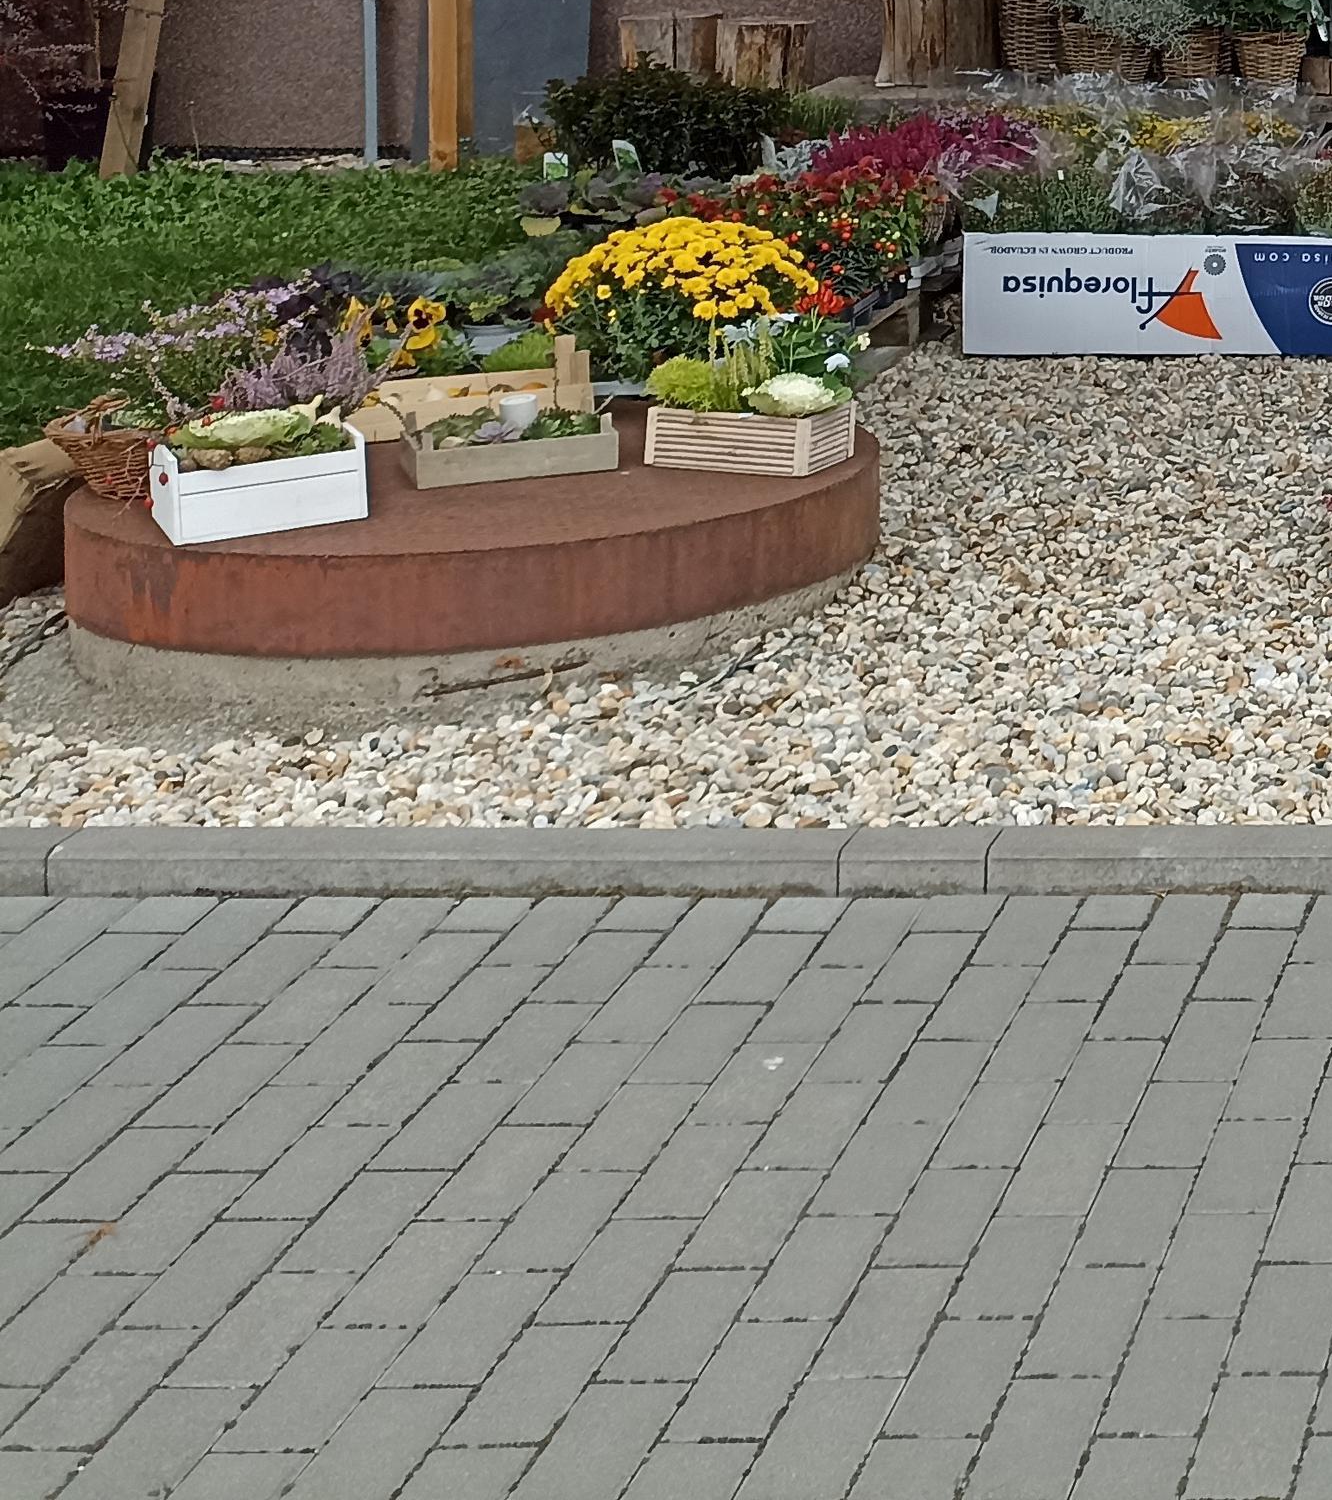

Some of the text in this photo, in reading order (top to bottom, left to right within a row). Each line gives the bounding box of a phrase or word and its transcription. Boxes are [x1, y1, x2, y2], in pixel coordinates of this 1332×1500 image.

[990, 246, 1036, 254] ECUADOR
[1051, 247, 1087, 255] GROWN
[1088, 247, 1133, 255] PRODUCT
[1002, 268, 1154, 315] florequisa
